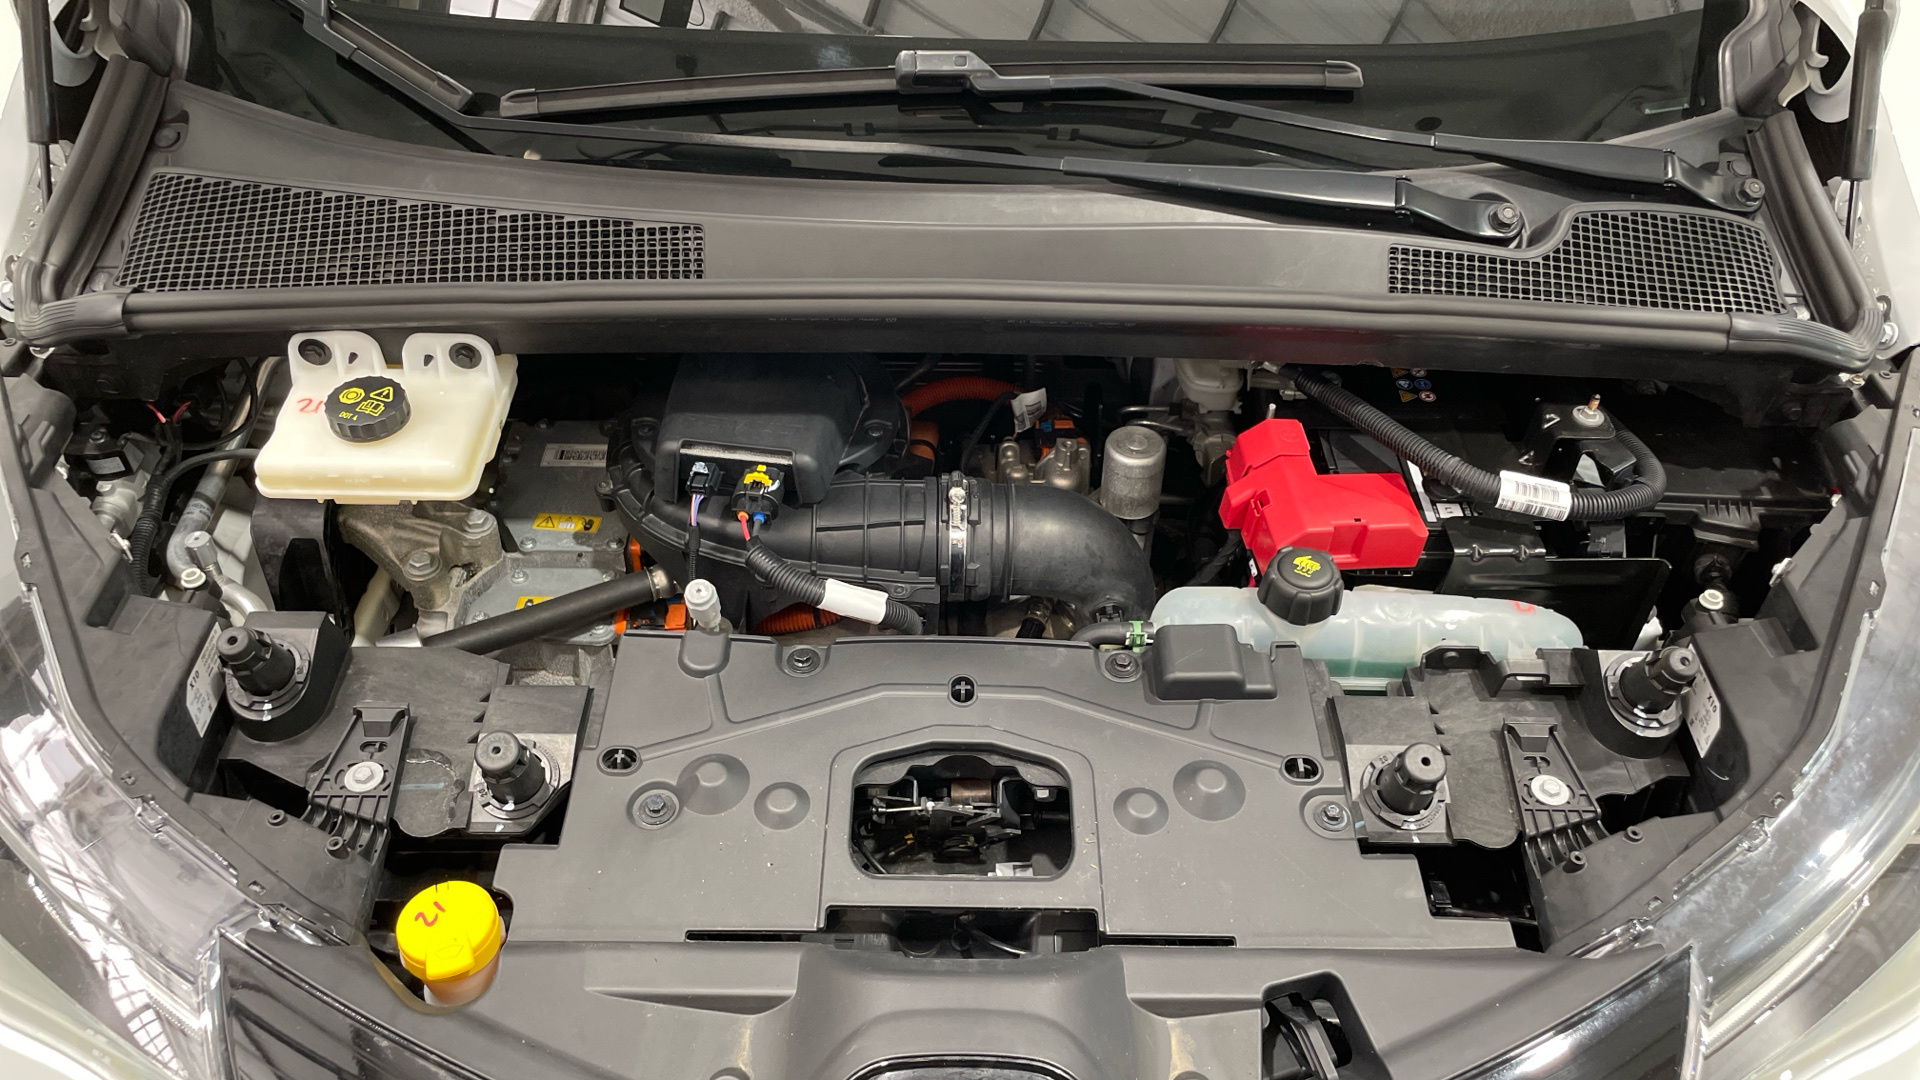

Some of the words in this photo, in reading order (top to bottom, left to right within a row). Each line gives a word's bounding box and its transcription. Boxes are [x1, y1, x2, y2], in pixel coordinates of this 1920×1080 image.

[297, 398, 324, 414] 21
[338, 411, 353, 419] DOT
[189, 670, 200, 690] X10
[1706, 693, 1718, 713] X10
[1379, 755, 1389, 764] 20
[478, 788, 488, 798] 20
[414, 901, 446, 927] 21
